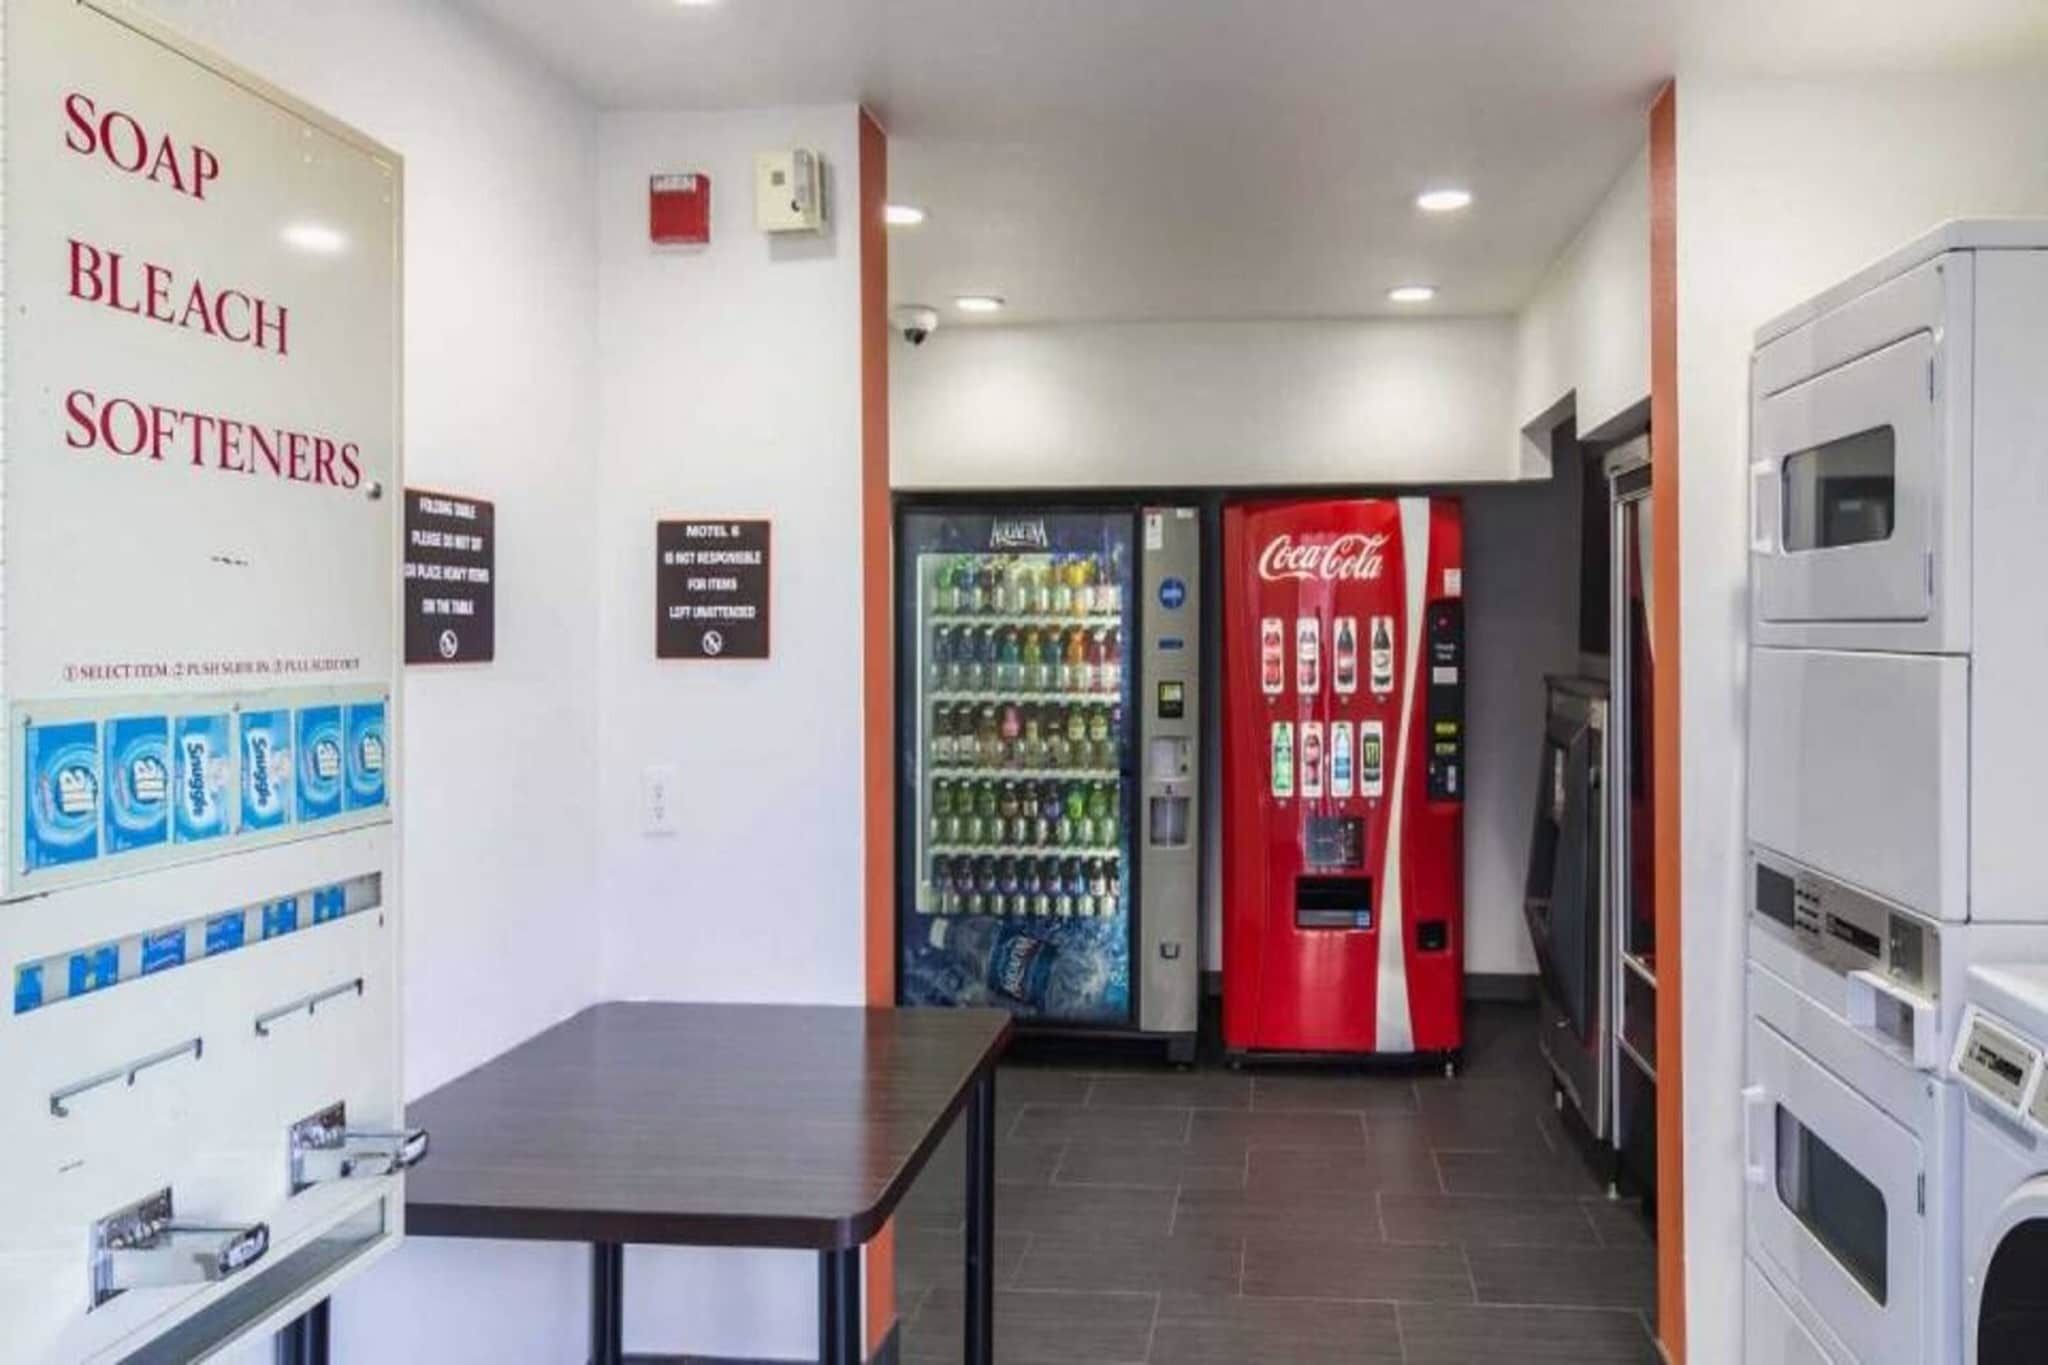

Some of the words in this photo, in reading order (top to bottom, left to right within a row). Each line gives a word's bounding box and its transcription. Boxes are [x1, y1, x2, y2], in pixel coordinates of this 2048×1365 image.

[65, 92, 218, 200] SOAP
[67, 238, 289, 356] BLEACH
[65, 389, 360, 490] SOFTENERS
[411, 530, 441, 547] PLEASE
[686, 525, 728, 537] MOTEL
[731, 525, 740, 537] 6
[664, 551, 674, 564] IS
[675, 551, 695, 564] NOT
[697, 551, 761, 564] RESPONSIBLE
[417, 563, 442, 580] PLACE
[688, 578, 706, 591] FOR
[708, 578, 737, 591] ITEMS
[669, 605, 691, 618] LEFT
[693, 605, 756, 618] UNATTENDED
[186, 741, 208, 818] Snuggle
[250, 735, 270, 807] Snuggle
